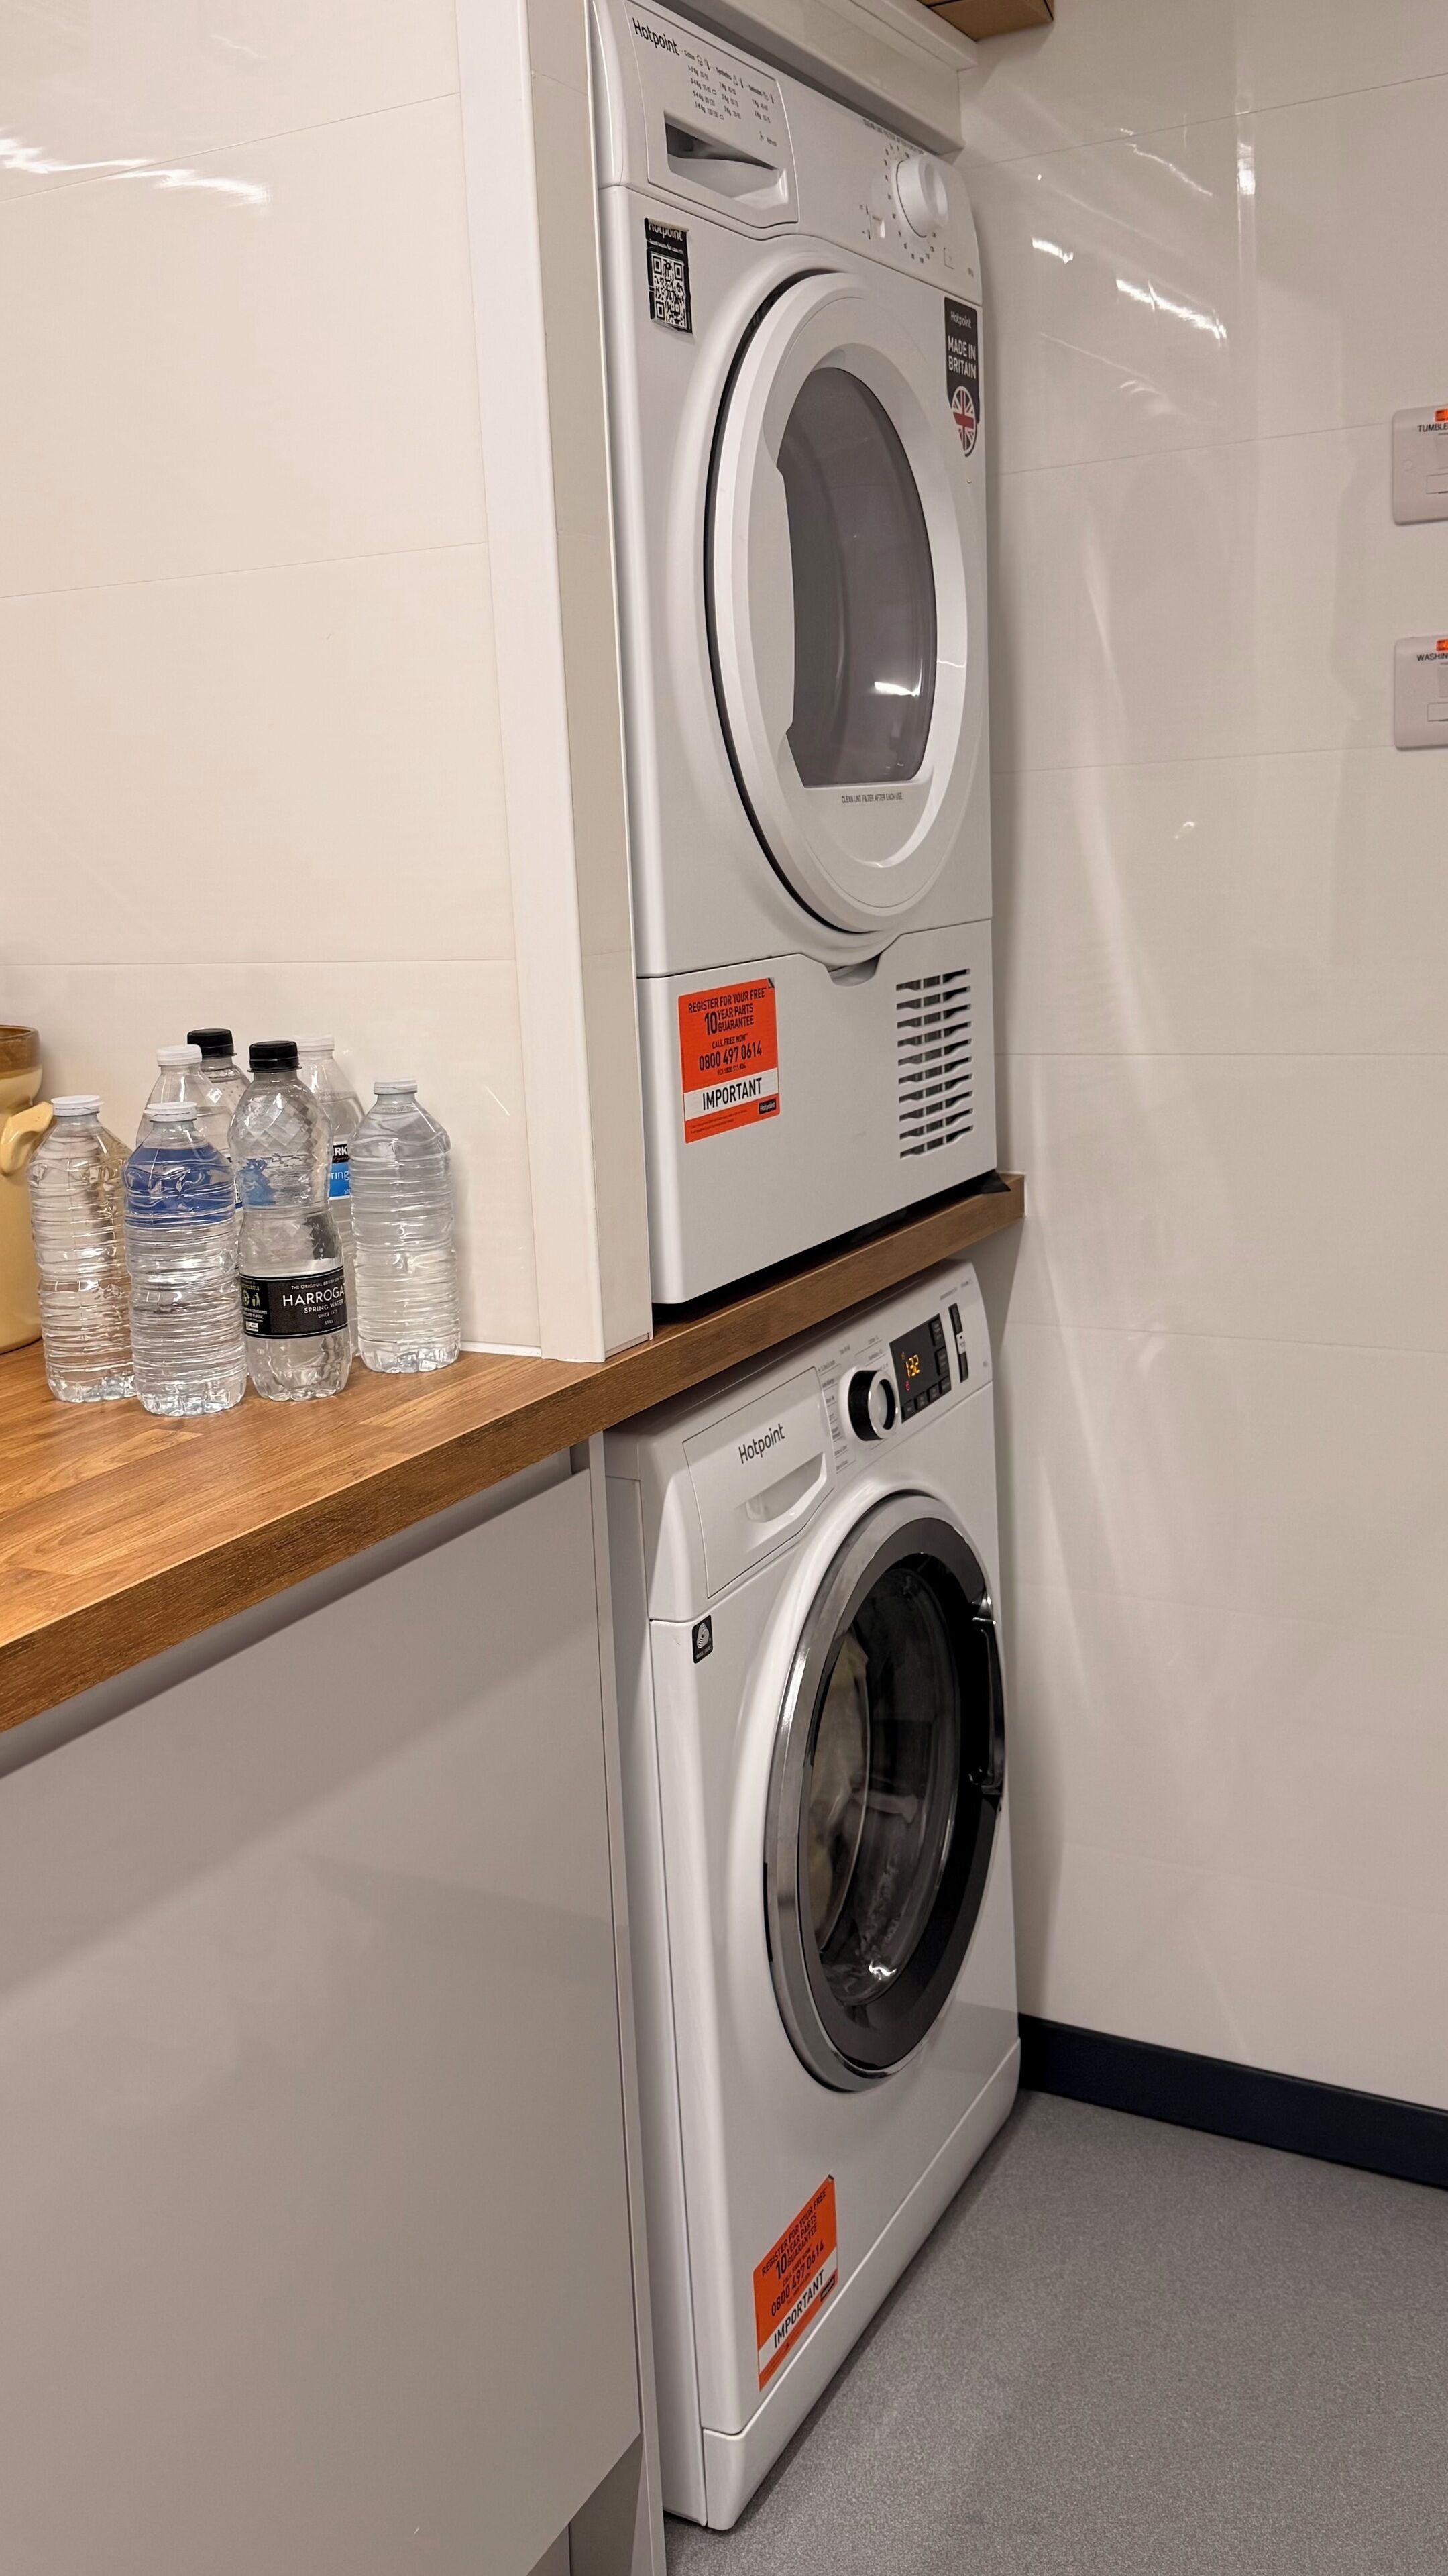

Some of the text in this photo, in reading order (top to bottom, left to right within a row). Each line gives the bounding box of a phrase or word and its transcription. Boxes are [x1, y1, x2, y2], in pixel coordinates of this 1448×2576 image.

[632, 18, 680, 56] Hotpoint
[950, 311, 972, 329] Hotpoint
[948, 335, 976, 360] MADE IN
[948, 355, 977, 379] BRITAIN
[688, 997, 719, 1013] REGISTER
[720, 994, 732, 1006] FOR
[733, 991, 749, 1003] YOUR
[704, 1003, 753, 1035] 10 YEAR PARTS
[718, 1015, 754, 1032] GUARANTEE
[699, 1040, 762, 1071] 0800 497 0614
[712, 1039, 724, 1049] CALL
[724, 1036, 735, 1045] FREE
[702, 1077, 762, 1110] IMPORTANT
[282, 1284, 345, 1307] HARROGA
[304, 1299, 343, 1313] SPRING WATER
[738, 1423, 785, 1464] Hotpoint
[762, 2239, 788, 2277] REGISTER
[789, 2224, 799, 2243] FOR
[799, 2206, 813, 2228] YOUR
[776, 2212, 816, 2280] 10 YEAR PARTS
[787, 2222, 817, 2267] GUARANTEE
[771, 2284, 790, 2316] 0800
[792, 2263, 805, 2290] 497
[807, 2239, 824, 2270] 0614
[774, 2269, 824, 2348] IMPORTANT
